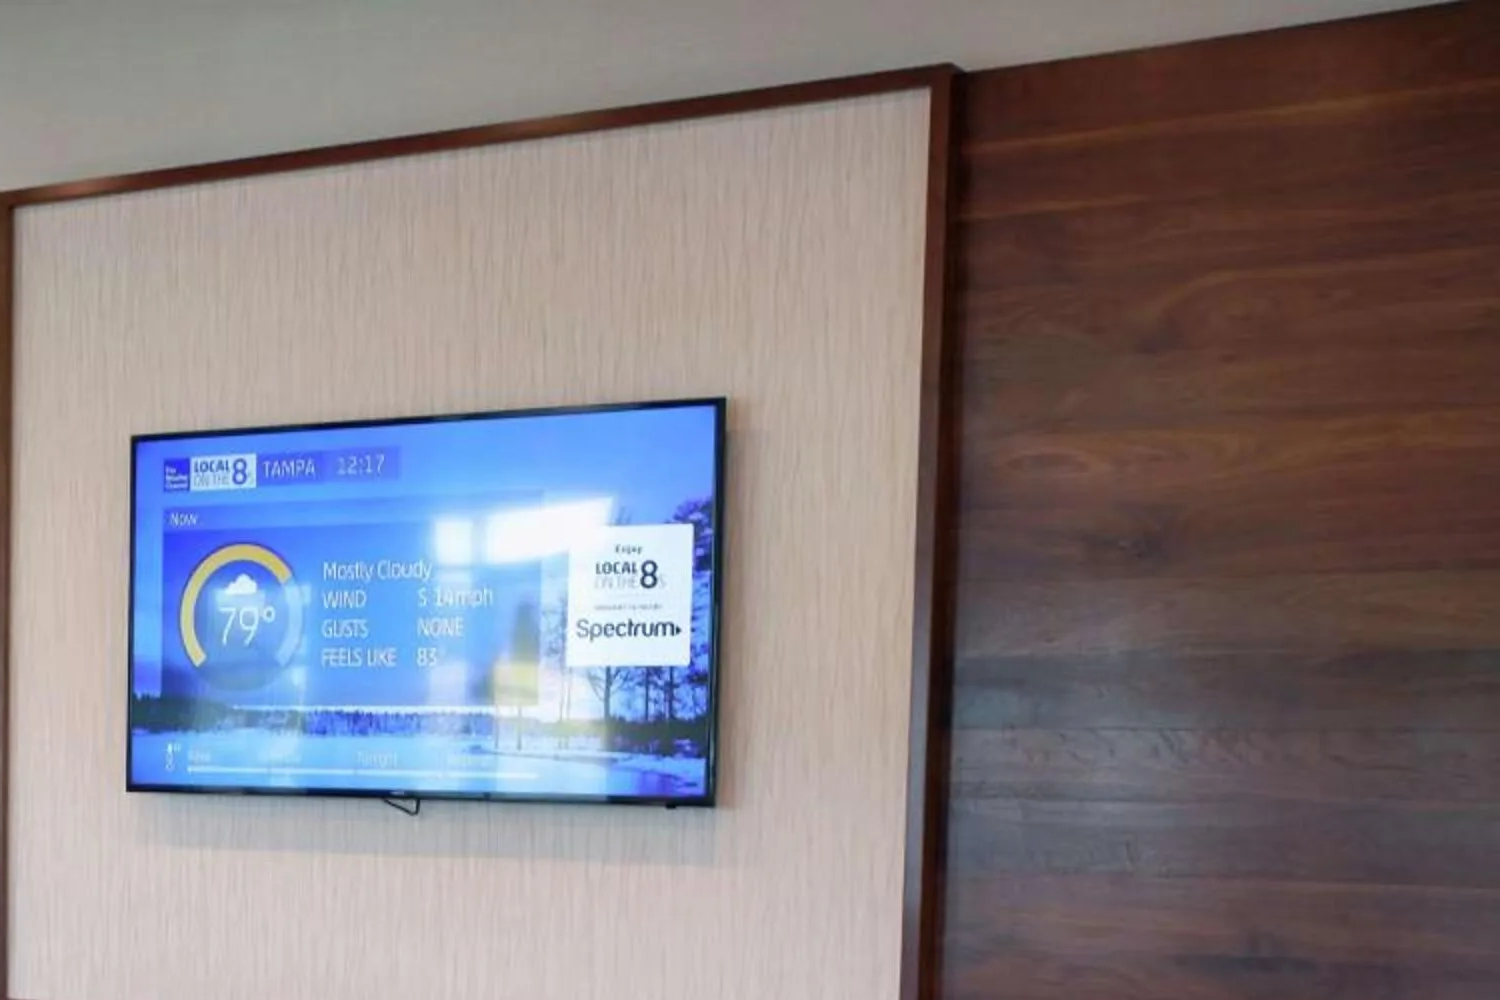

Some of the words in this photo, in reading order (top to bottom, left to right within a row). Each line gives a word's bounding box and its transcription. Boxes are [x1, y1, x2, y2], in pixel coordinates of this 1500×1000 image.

[194, 459, 230, 473] LOCAL
[263, 460, 316, 478] TAMPA
[337, 455, 385, 475] 12:17
[323, 561, 374, 583] Mostly
[377, 559, 433, 581] Cloudy
[595, 561, 638, 574] LOCAL
[323, 590, 367, 608] WIND
[321, 619, 369, 639] GUSTS
[417, 617, 464, 637] NONE
[576, 618, 675, 642] Spectrum
[322, 647, 363, 667] FEELS
[367, 647, 397, 667] LIKE
